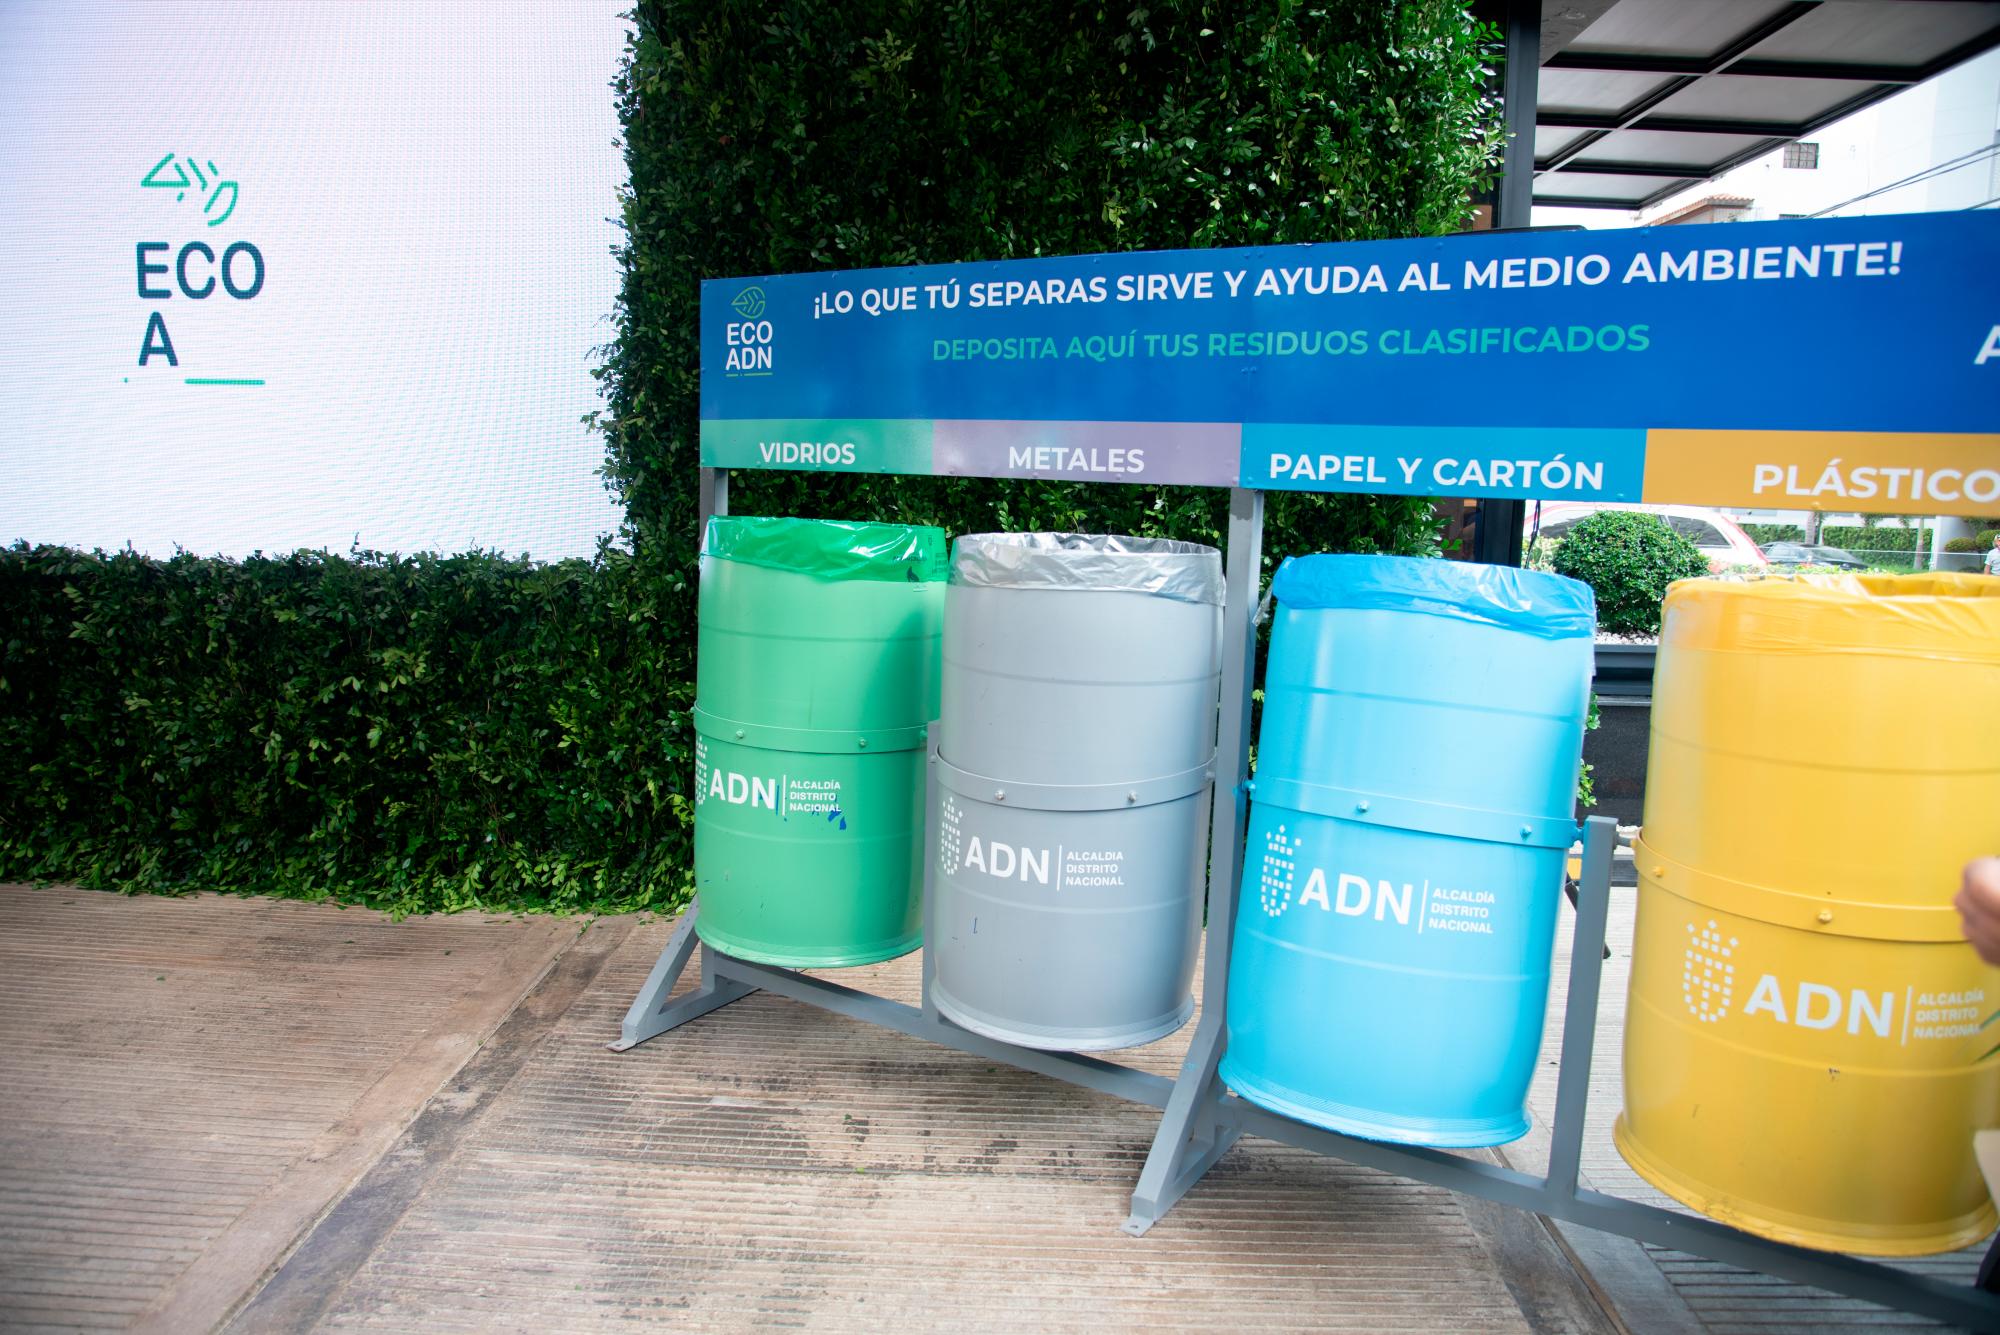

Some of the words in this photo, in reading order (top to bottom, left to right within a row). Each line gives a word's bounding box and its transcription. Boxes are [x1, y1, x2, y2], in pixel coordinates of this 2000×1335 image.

[136, 240, 265, 300] ECO
[814, 290, 854, 319] ¡LO
[861, 286, 917, 316] QUE
[924, 277, 960, 309] TÚ
[969, 276, 1108, 308] SEPARAS
[1116, 271, 1213, 302] SIRVE
[1223, 270, 1247, 297] Y
[1254, 264, 1388, 296] AYUDA
[1398, 262, 1451, 292] AL
[1464, 254, 1611, 290] MEDIO
[1622, 241, 1903, 284] AMBIENTE!
[138, 311, 179, 367] A
[727, 320, 773, 346] ECO
[933, 337, 1059, 361] DEPOSITA
[1065, 329, 1137, 363] AQUÍ
[1143, 333, 1199, 357] TUS
[1208, 329, 1369, 357] RESIDUOS
[1378, 324, 1650, 355] CLASIFICADOS
[725, 346, 772, 371] ADN
[759, 442, 856, 465] VIDRIOS
[1008, 445, 1145, 474] METALES
[1270, 453, 1387, 483] PAPEL
[1397, 457, 1423, 484] Y
[1432, 453, 1604, 490] CARTÓN
[1752, 458, 2000, 503] PLÁSTICO
[709, 768, 776, 810] ADN
[790, 779, 841, 790] ALCALDÍA
[790, 791, 836, 801] DISTRITO
[789, 802, 842, 812] NACIONAL
[964, 836, 1050, 884] ADN
[1066, 863, 1118, 874] DISTRITO
[1065, 876, 1125, 886] NACIONAL
[1298, 867, 1414, 926] ADN
[1432, 887, 1495, 904] ALCALDÍA
[1430, 902, 1489, 919] DISTRITO
[1428, 917, 1494, 934] NACIONAL
[1743, 974, 1895, 1038] ADN
[1915, 1008, 1979, 1023] DISTRITO
